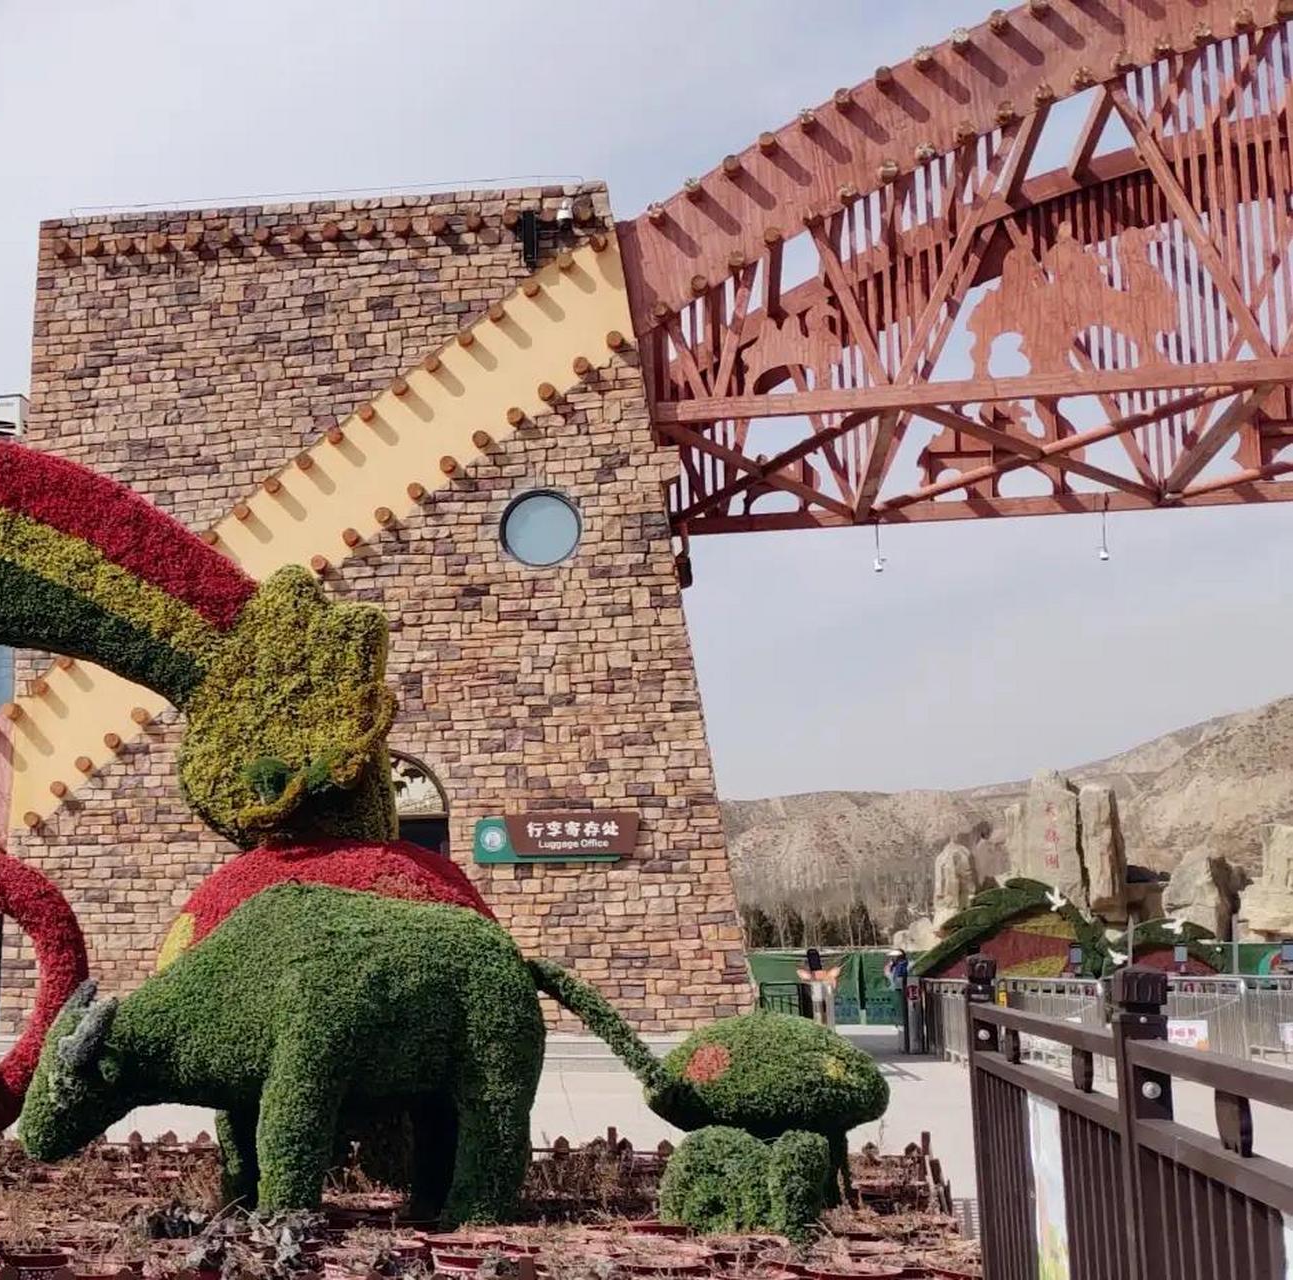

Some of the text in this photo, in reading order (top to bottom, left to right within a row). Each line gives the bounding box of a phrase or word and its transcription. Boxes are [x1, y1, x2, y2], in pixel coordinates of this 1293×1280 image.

[527, 821, 619, 837] 行李寄存处
[538, 839, 610, 849] Luggage Office
